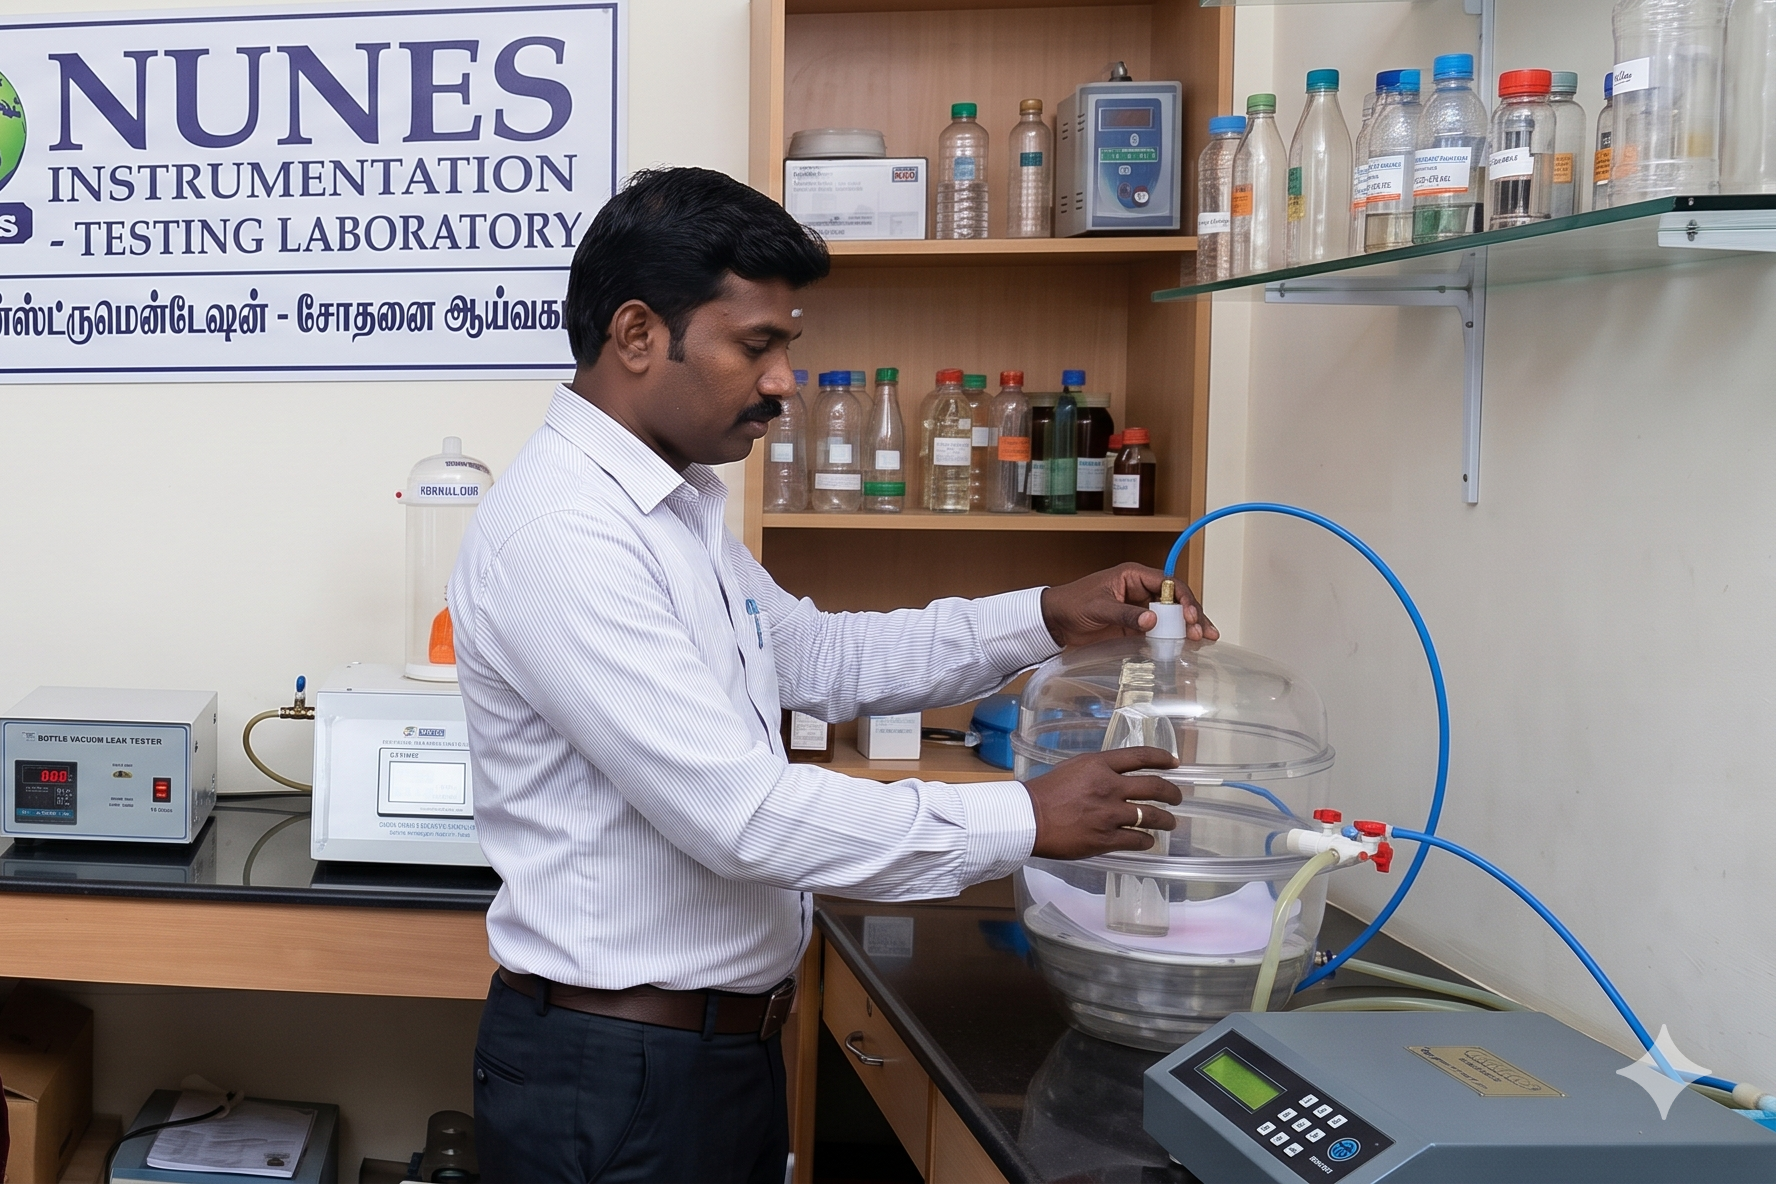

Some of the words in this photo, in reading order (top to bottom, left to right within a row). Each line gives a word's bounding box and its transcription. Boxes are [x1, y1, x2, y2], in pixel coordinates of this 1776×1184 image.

[48, 37, 574, 152] NUNES
[48, 154, 578, 203] INSTRUMENTATION
[75, 217, 264, 258] TESTING
[277, 211, 582, 253] LABORATORY
[297, 293, 436, 343] சோதனை
[444, 285, 569, 338] ஆய்வக
[37, 734, 68, 742] BOTTLE
[106, 736, 128, 744] LEAK
[130, 737, 163, 746] TESTER
